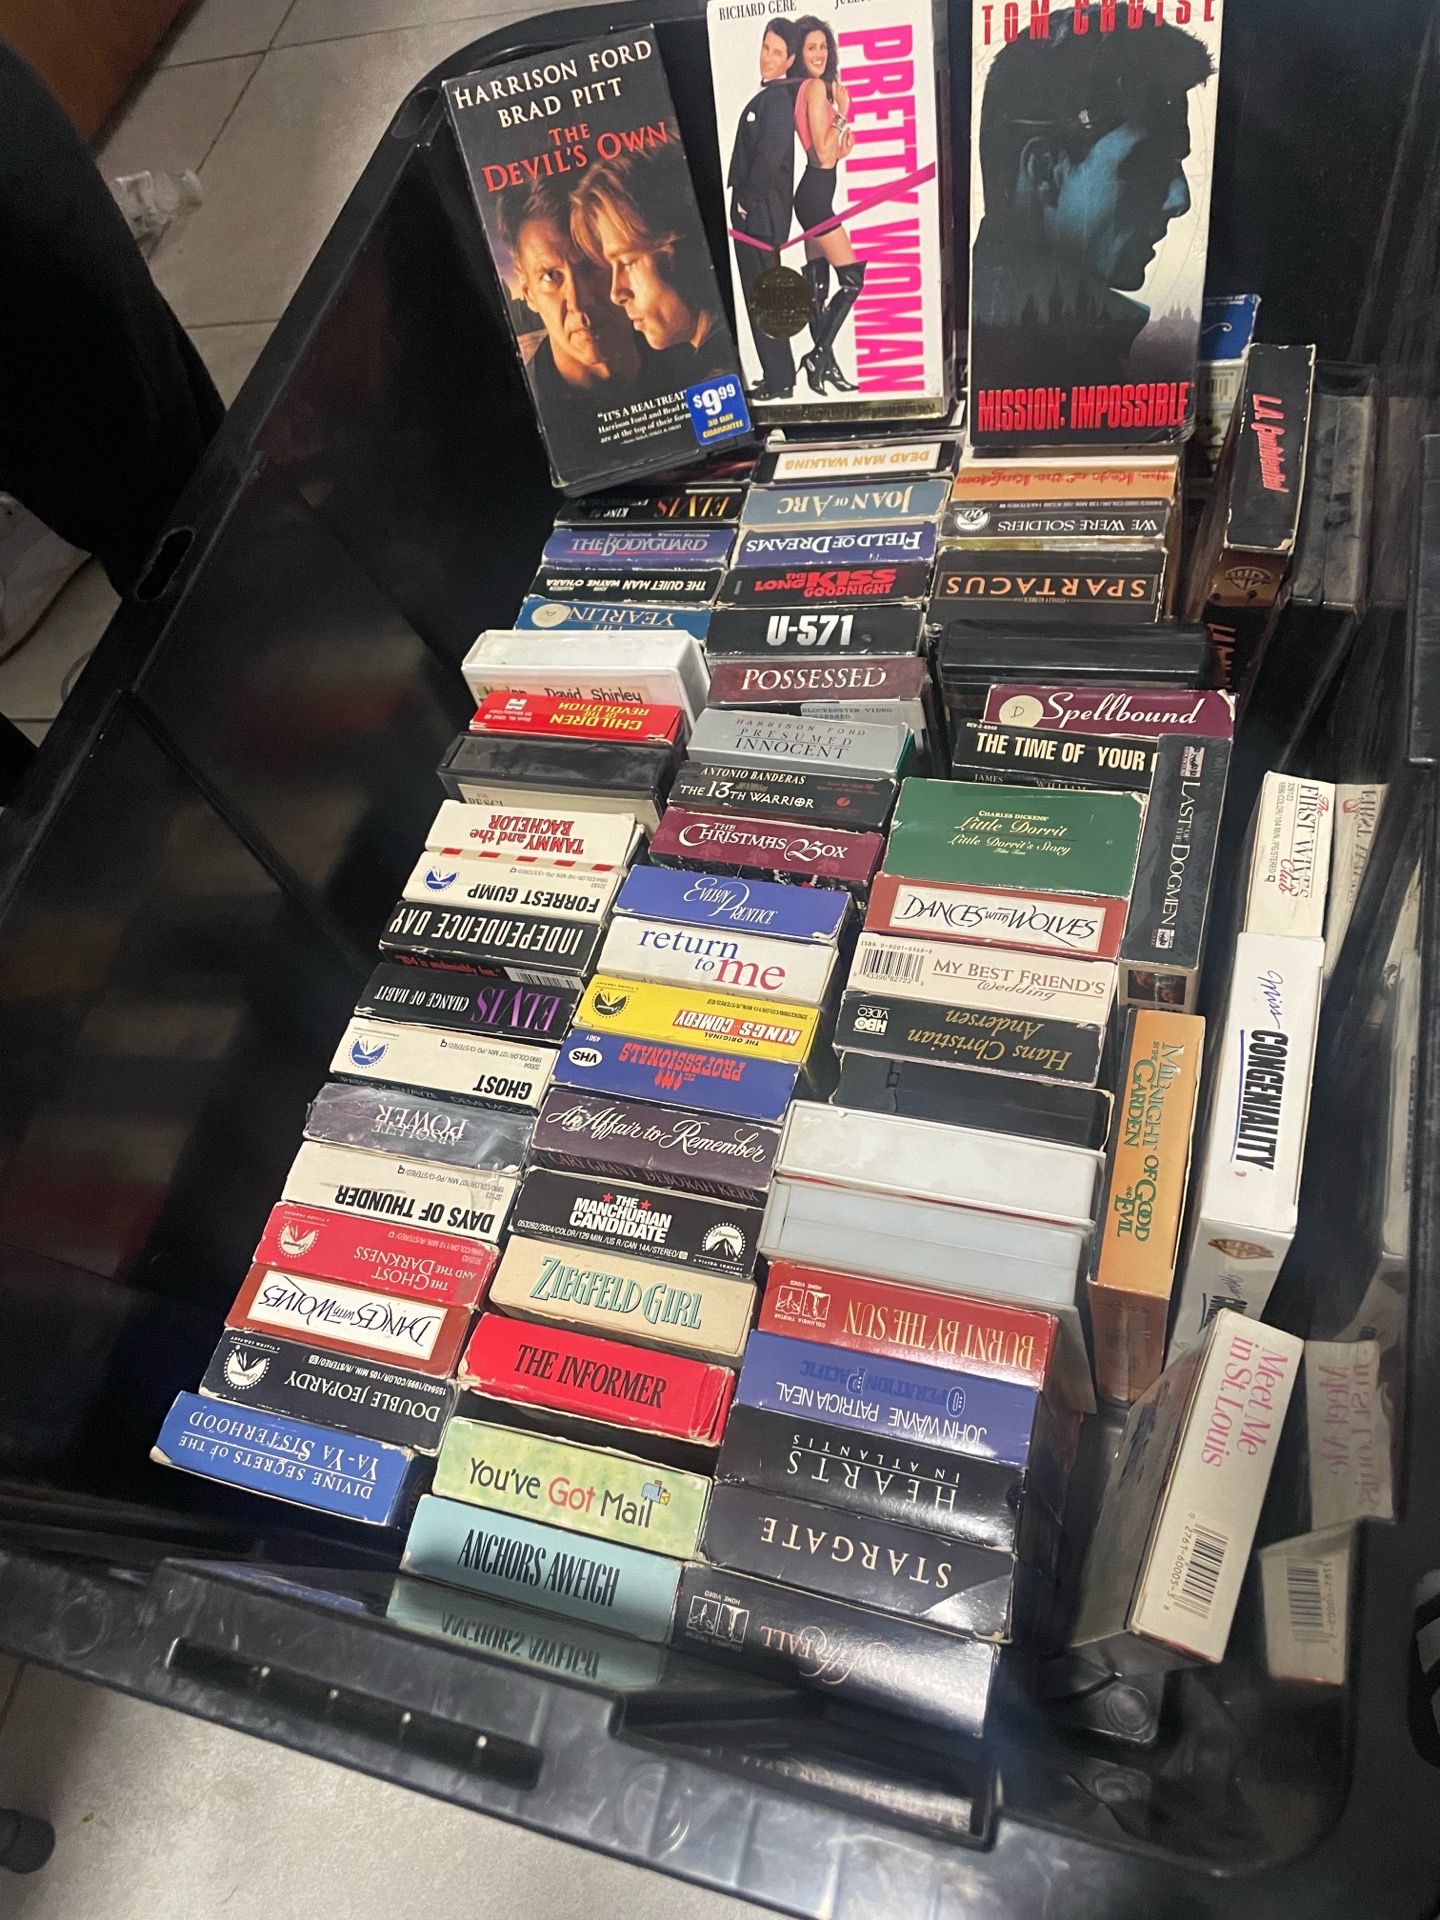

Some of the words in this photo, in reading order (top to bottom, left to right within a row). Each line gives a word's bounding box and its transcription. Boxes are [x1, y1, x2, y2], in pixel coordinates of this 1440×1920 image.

[719, 2, 765, 21] RICHARD
[768, 0, 796, 14] GERE
[982, 2, 1050, 45] TOM
[454, 59, 578, 109] HARRISON
[589, 39, 652, 72] FORD
[498, 95, 561, 129] BRAD
[571, 77, 622, 108] PITT
[838, 24, 925, 206] PRETTY
[549, 123, 591, 146] THE
[482, 144, 587, 192] DEVIL'S
[596, 121, 669, 160] OWN
[850, 218, 925, 393] WOMAN
[598, 421, 630, 433] Harrison
[631, 414, 647, 424] Ford
[649, 409, 661, 418] and
[663, 406, 680, 414] Brad
[978, 388, 1066, 432] MISSION:
[1071, 382, 1194, 429] IMPOSSIBLE
[656, 416, 673, 426] their
[785, 458, 847, 470] WALKING
[853, 456, 886, 465] MAN
[890, 451, 929, 463] DEAD
[998, 520, 1075, 531] SOLDIERS
[1079, 520, 1124, 531] WERE
[1131, 520, 1157, 530] WE
[747, 536, 831, 553] DREAMS
[832, 535, 856, 547] OF
[857, 532, 923, 549] FIELD
[622, 580, 650, 589] MAN
[651, 581, 683, 590] QUIET
[687, 581, 706, 590] THE
[755, 580, 806, 591] LONG
[804, 583, 893, 597] GOODNIGHT
[806, 568, 896, 588] KISS
[946, 577, 1146, 597] SPARTACUS
[767, 615, 853, 645] U-571
[741, 668, 887, 690] POSSESSED
[591, 688, 643, 703] Shirley
[549, 714, 643, 730] CHILDREN
[1041, 691, 1206, 729] Spellbound
[735, 738, 849, 759] INNOCENT
[976, 732, 1010, 754] THE
[1014, 737, 1058, 760] TIME
[1061, 743, 1086, 763] OF
[1098, 746, 1146, 771] YOUR
[701, 767, 748, 779] ANTONIO
[750, 770, 806, 784] BANDERAS
[978, 810, 1013, 819] CHARLES
[1296, 783, 1319, 833] FIRST
[469, 828, 495, 844] the
[488, 815, 574, 836] BACHELOR
[713, 822, 736, 832] THE
[955, 816, 1002, 832] Little
[1009, 820, 1068, 837] Dorrit
[496, 832, 526, 845] and
[524, 834, 584, 854] TAMMY
[1289, 840, 1313, 898] WIVES
[467, 883, 518, 903] GUMP
[520, 890, 600, 913] FORREST
[389, 908, 432, 935] DAY
[432, 913, 583, 955] INDEPENDENCE
[638, 929, 739, 960] return
[694, 957, 715, 971] to
[713, 959, 786, 991] me
[932, 958, 964, 974] MY
[968, 963, 1013, 981] BEST
[1020, 969, 1106, 995] FRIEND'S
[374, 986, 410, 1003] HABIT
[409, 992, 427, 1006] OF
[430, 992, 470, 1012] CHANGE
[1257, 970, 1284, 1029] Miss
[471, 986, 560, 1032] ELVIS
[857, 1006, 889, 1020] VIDEO
[673, 1010, 734, 1034] COMEDY
[737, 1021, 800, 1044] KINGS
[943, 1008, 1044, 1041] Andersen
[704, 1032, 743, 1044] ORIGINAL
[744, 1038, 759, 1046] THE
[907, 1028, 1006, 1060] Christian
[572, 1051, 598, 1064] VHS
[618, 1043, 745, 1082] PROFESSIONALS
[1012, 1044, 1072, 1071] Hans
[472, 1074, 532, 1100] GHOST
[1236, 1029, 1289, 1170] CONGENIALITY
[1124, 1059, 1157, 1148] GARDEN
[1144, 1155, 1159, 1180] OF
[335, 1185, 415, 1218] THUNDER
[418, 1202, 444, 1223] OF
[573, 1198, 673, 1228] MANCHURIAN
[616, 1195, 639, 1208] THE
[1134, 1180, 1157, 1242] GOOD
[447, 1207, 495, 1234] DAYS
[570, 1211, 669, 1243] CANDIDATE
[353, 1246, 435, 1275] DARKNESS
[436, 1265, 453, 1276] THE
[371, 1266, 430, 1290] GHOST
[429, 1279, 448, 1291] THE
[455, 1269, 476, 1279] AND
[789, 1279, 806, 1288] VIDEO
[530, 1256, 642, 1314] ZIEGFELD
[642, 1282, 703, 1329] GIRL
[797, 1318, 826, 1328] COLUMBIA
[842, 1300, 888, 1341] SUN
[887, 1309, 928, 1349] THE
[926, 1318, 960, 1354] BY
[960, 1324, 1035, 1371] BURNT
[1230, 1334, 1259, 1362] in
[284, 1370, 370, 1404] JEOPARDY
[514, 1344, 559, 1380] THE
[557, 1356, 667, 1409] INFORMER
[1219, 1362, 1253, 1392] St.
[1248, 1349, 1289, 1410] Meet
[371, 1391, 441, 1422] DOUBLE
[775, 1382, 814, 1407] NEAL
[816, 1394, 879, 1422] PATRICIA
[887, 1406, 940, 1435] WAYNE
[189, 1410, 315, 1462] SISTERHOOD
[943, 1419, 987, 1444] JOHN
[1200, 1393, 1245, 1468] Louis
[1236, 1414, 1271, 1457] Me
[178, 1435, 205, 1453] THE
[210, 1445, 228, 1462] OF
[791, 1434, 919, 1473] ATLANTIS
[232, 1450, 306, 1481] SECRETS
[322, 1444, 379, 1481] YA-YA
[312, 1472, 372, 1499] DIVINE
[786, 1450, 957, 1511] HEARTS
[934, 1467, 960, 1484] IN
[469, 1457, 541, 1499] You've
[548, 1477, 596, 1512] Got
[600, 1489, 655, 1528] Mail
[760, 1517, 952, 1589] STARGATE
[458, 1529, 546, 1587] ANCHORS
[544, 1551, 621, 1608] AWEIGH
[704, 1589, 722, 1601] VIDEO
